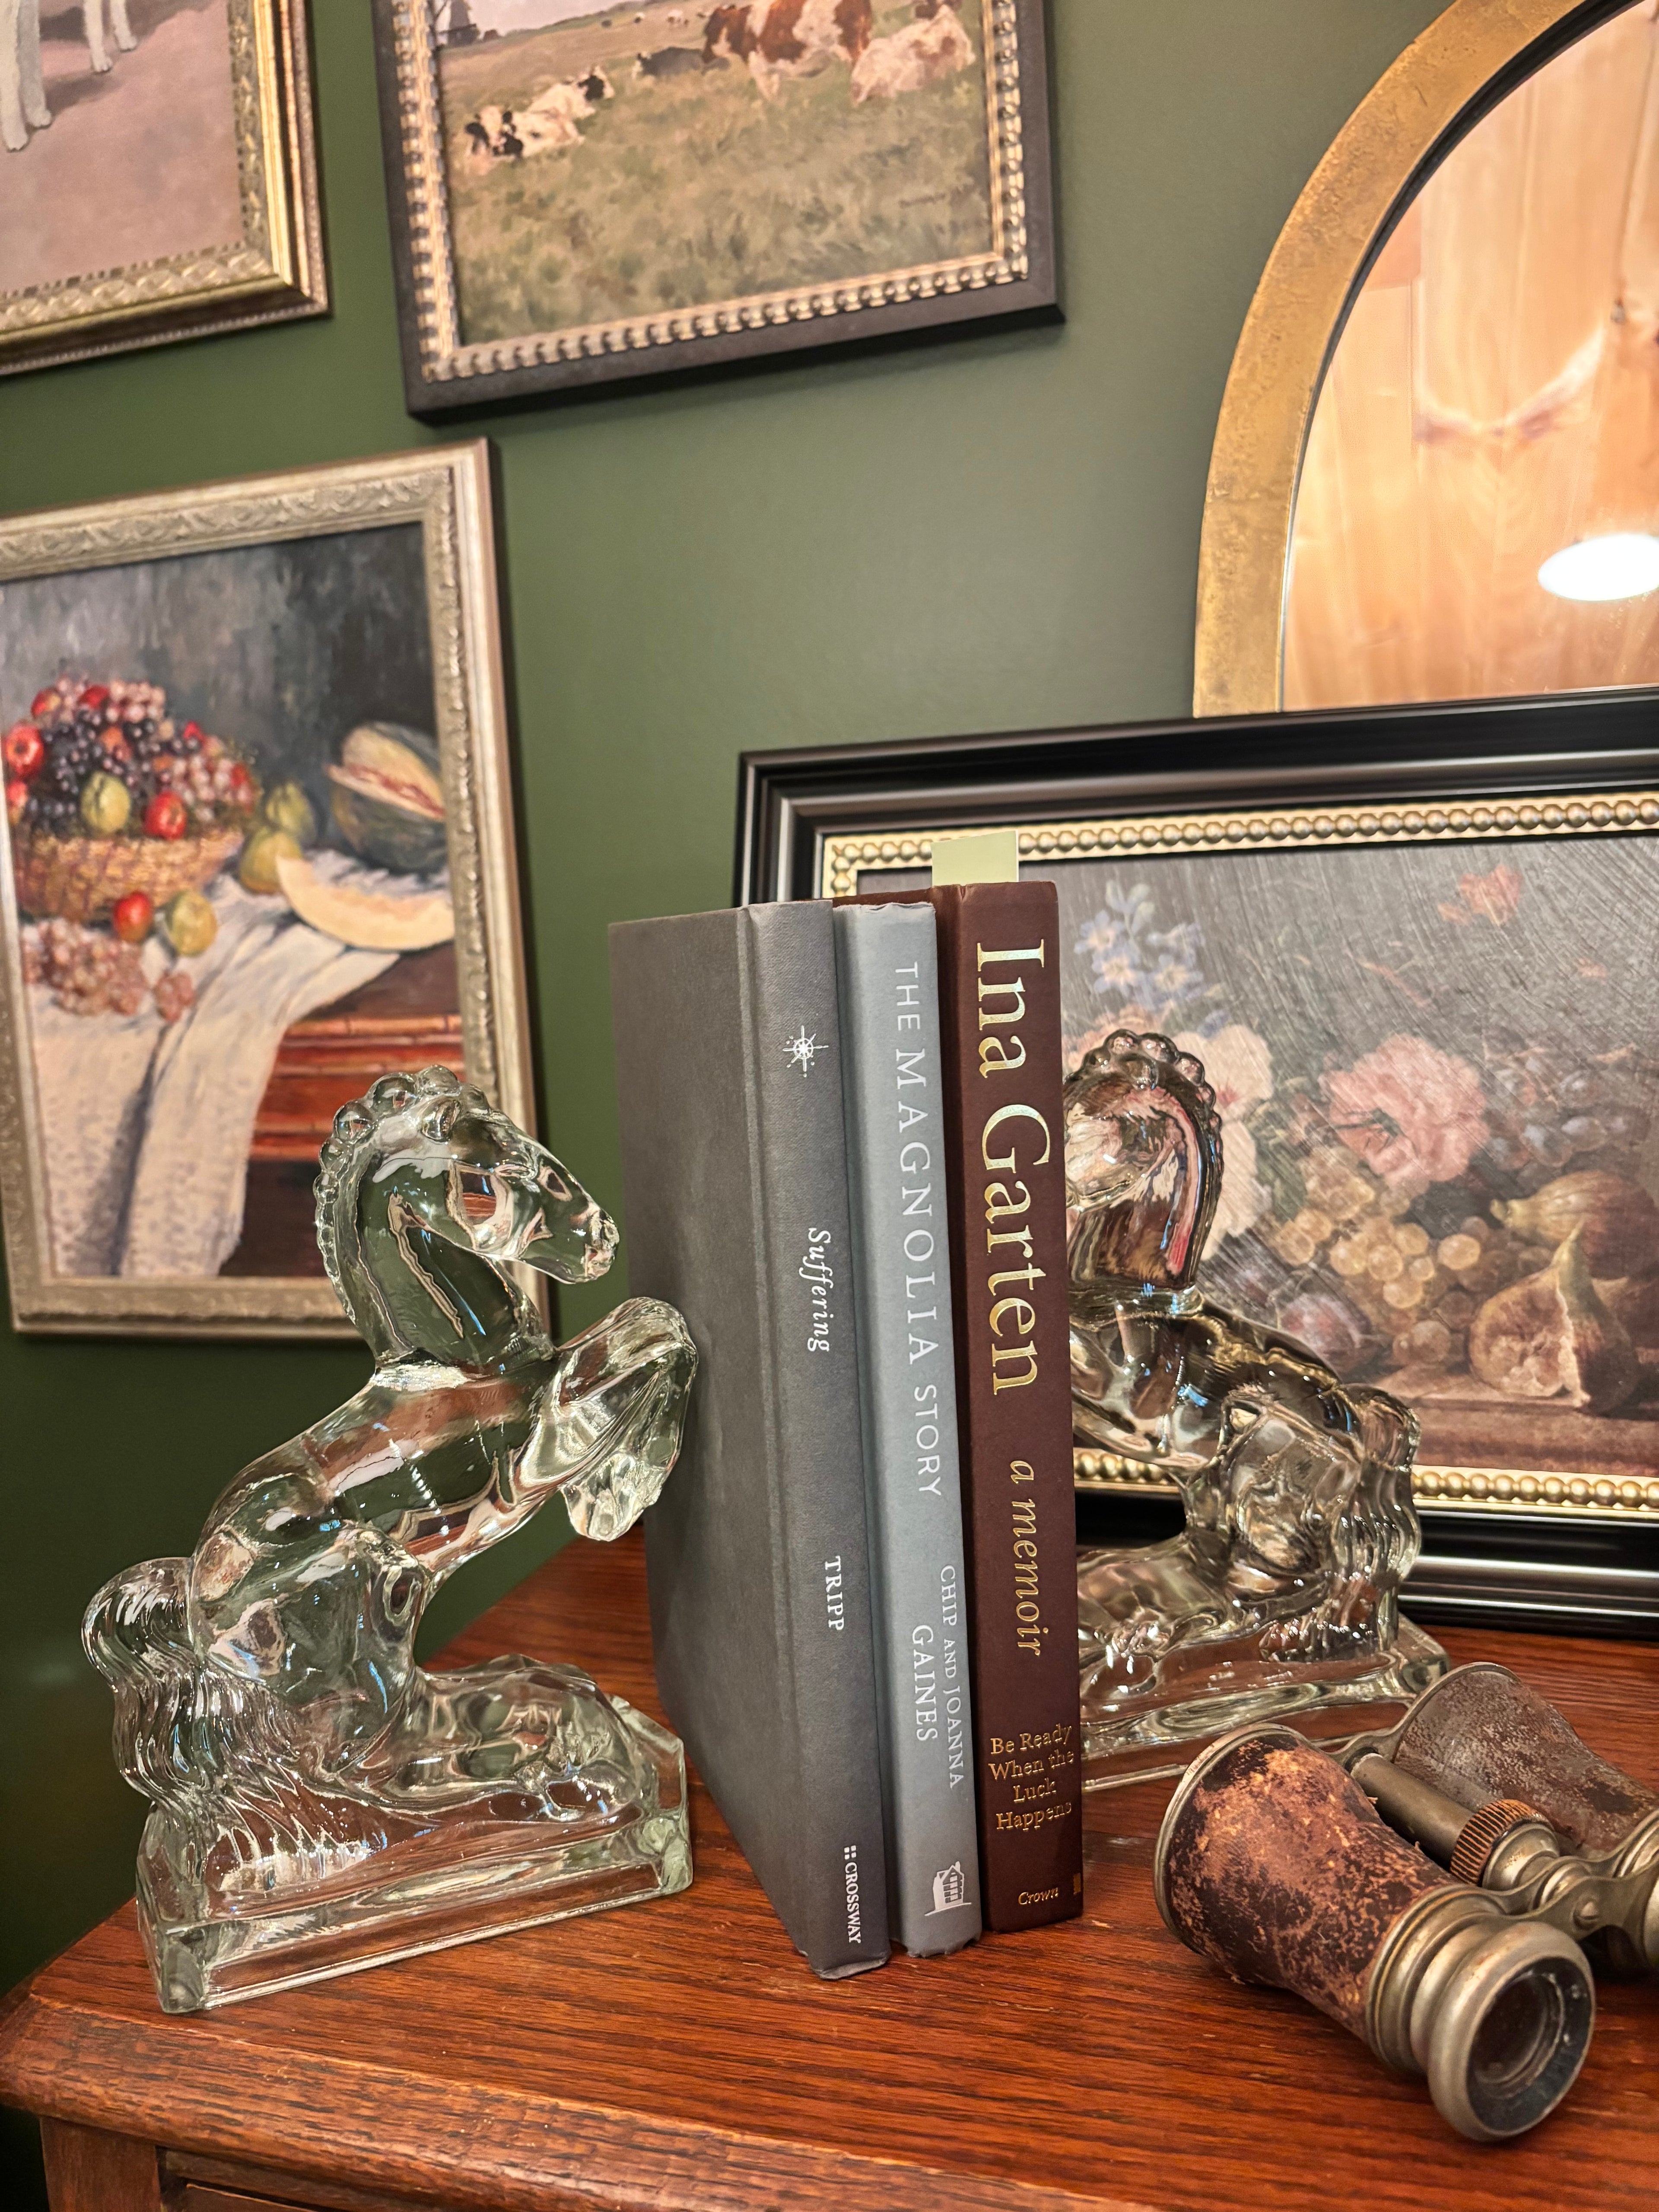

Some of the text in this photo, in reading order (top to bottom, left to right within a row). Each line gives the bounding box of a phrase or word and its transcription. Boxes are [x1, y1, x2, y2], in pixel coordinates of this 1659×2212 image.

[977, 939, 1050, 1395] Ina Garten
[896, 962, 941, 1495] THE MAGNOLIA STORY
[799, 1228, 833, 1351] Suffering
[825, 1556, 844, 1630] TRIPP
[1011, 1461, 1046, 1656] a memoir
[912, 1625, 938, 1741] GAINES
[941, 1566, 963, 1789] CHIP AND JOANNA
[988, 1749, 1074, 1780] When the
[991, 1723, 1071, 1754] Be Ready
[996, 1802, 1072, 1831] Happens
[1013, 1777, 1056, 1802] Luck
[845, 1862, 861, 1943] CROSSWAY
[1019, 1888, 1058, 1904] Crown
